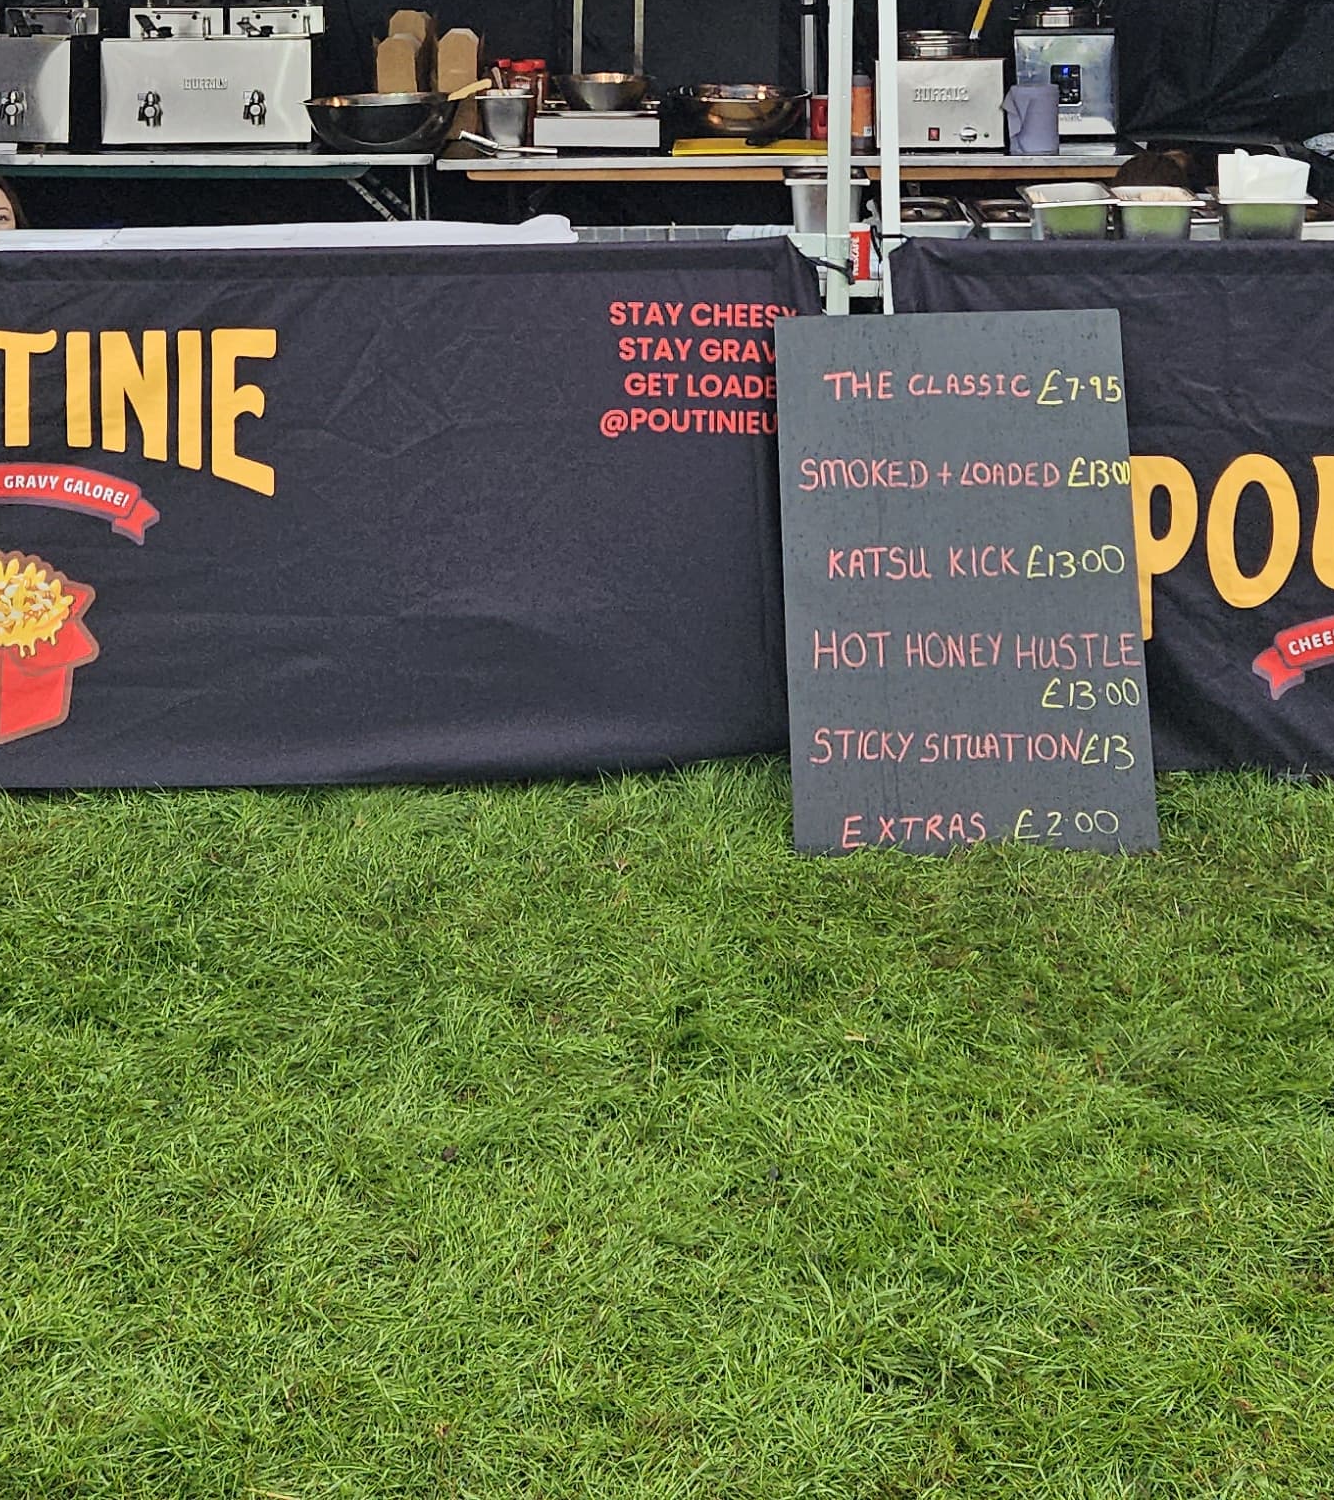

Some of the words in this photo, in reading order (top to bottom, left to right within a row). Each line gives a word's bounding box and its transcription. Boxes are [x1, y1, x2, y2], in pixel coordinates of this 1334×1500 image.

[609, 302, 683, 327] STAY
[619, 338, 692, 362] STAY
[699, 339, 776, 363] GRAV
[624, 373, 679, 397] GET
[687, 374, 777, 399] LOADE
[823, 371, 894, 400] THE
[908, 374, 1032, 398] CLASSIC
[600, 407, 779, 438] @POUTINIEU
[798, 459, 928, 491] SMOKED
[937, 466, 952, 482] +
[960, 461, 1061, 487] LOADED
[4, 475, 60, 492] GRAVY
[63, 478, 131, 509] GALORE!
[828, 547, 932, 580] KATSU
[950, 547, 1019, 577] KICK
[814, 630, 891, 670] HOT
[905, 632, 1003, 668] HONEY
[1016, 632, 1141, 670] HUSTLE
[810, 728, 914, 764] STICKY
[920, 728, 1084, 763] SITUATION
[1081, 735, 1135, 770] £13
[842, 813, 987, 848] EXTRAS
